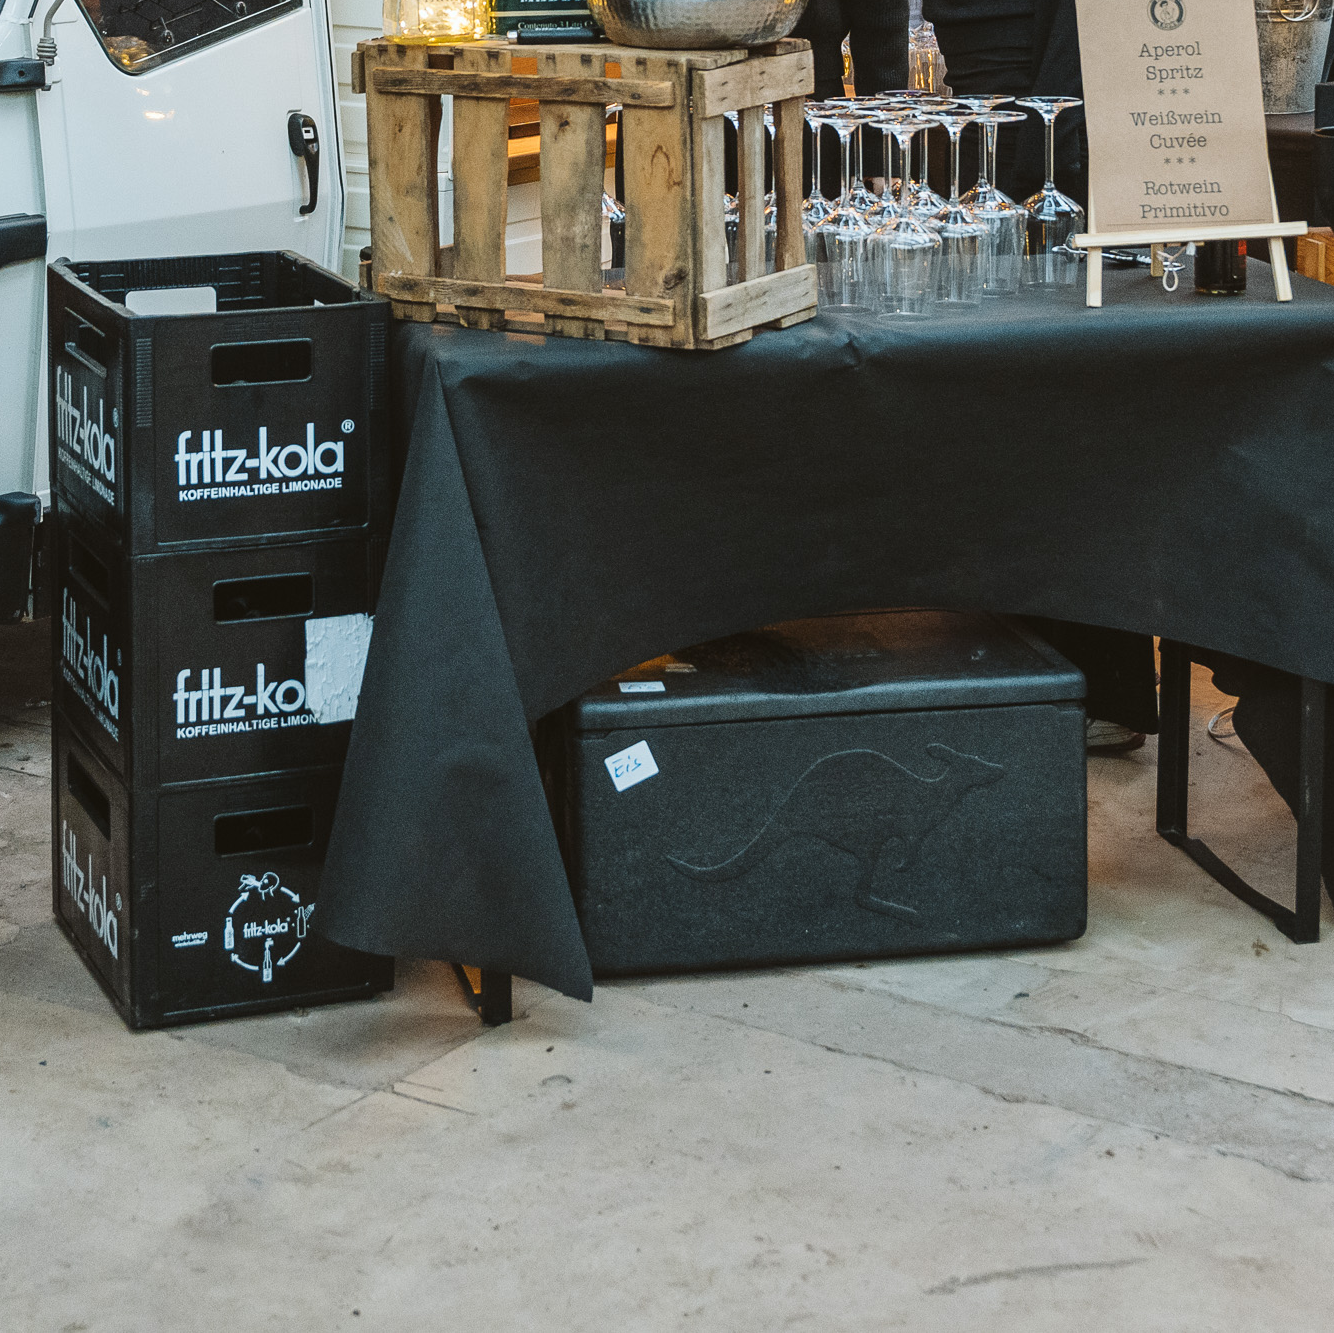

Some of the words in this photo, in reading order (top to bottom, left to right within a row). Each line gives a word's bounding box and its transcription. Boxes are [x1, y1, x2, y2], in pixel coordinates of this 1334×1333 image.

[1138, 41, 1203, 60] Aperol
[1145, 65, 1204, 83] Spritz
[1129, 109, 1223, 128] Weißwein
[1149, 132, 1207, 150] Cuvée
[1143, 179, 1222, 197] Rotwein
[1140, 202, 1230, 220] Primitivo
[178, 483, 280, 503] KOFFEINHALTIGE
[281, 476, 343, 495] LIMONADE
[172, 662, 313, 724] fritz-ko
[176, 719, 279, 740] KOFFEINHALTIGE
[280, 712, 322, 728] LIMON
[171, 930, 209, 943] mehrweg
